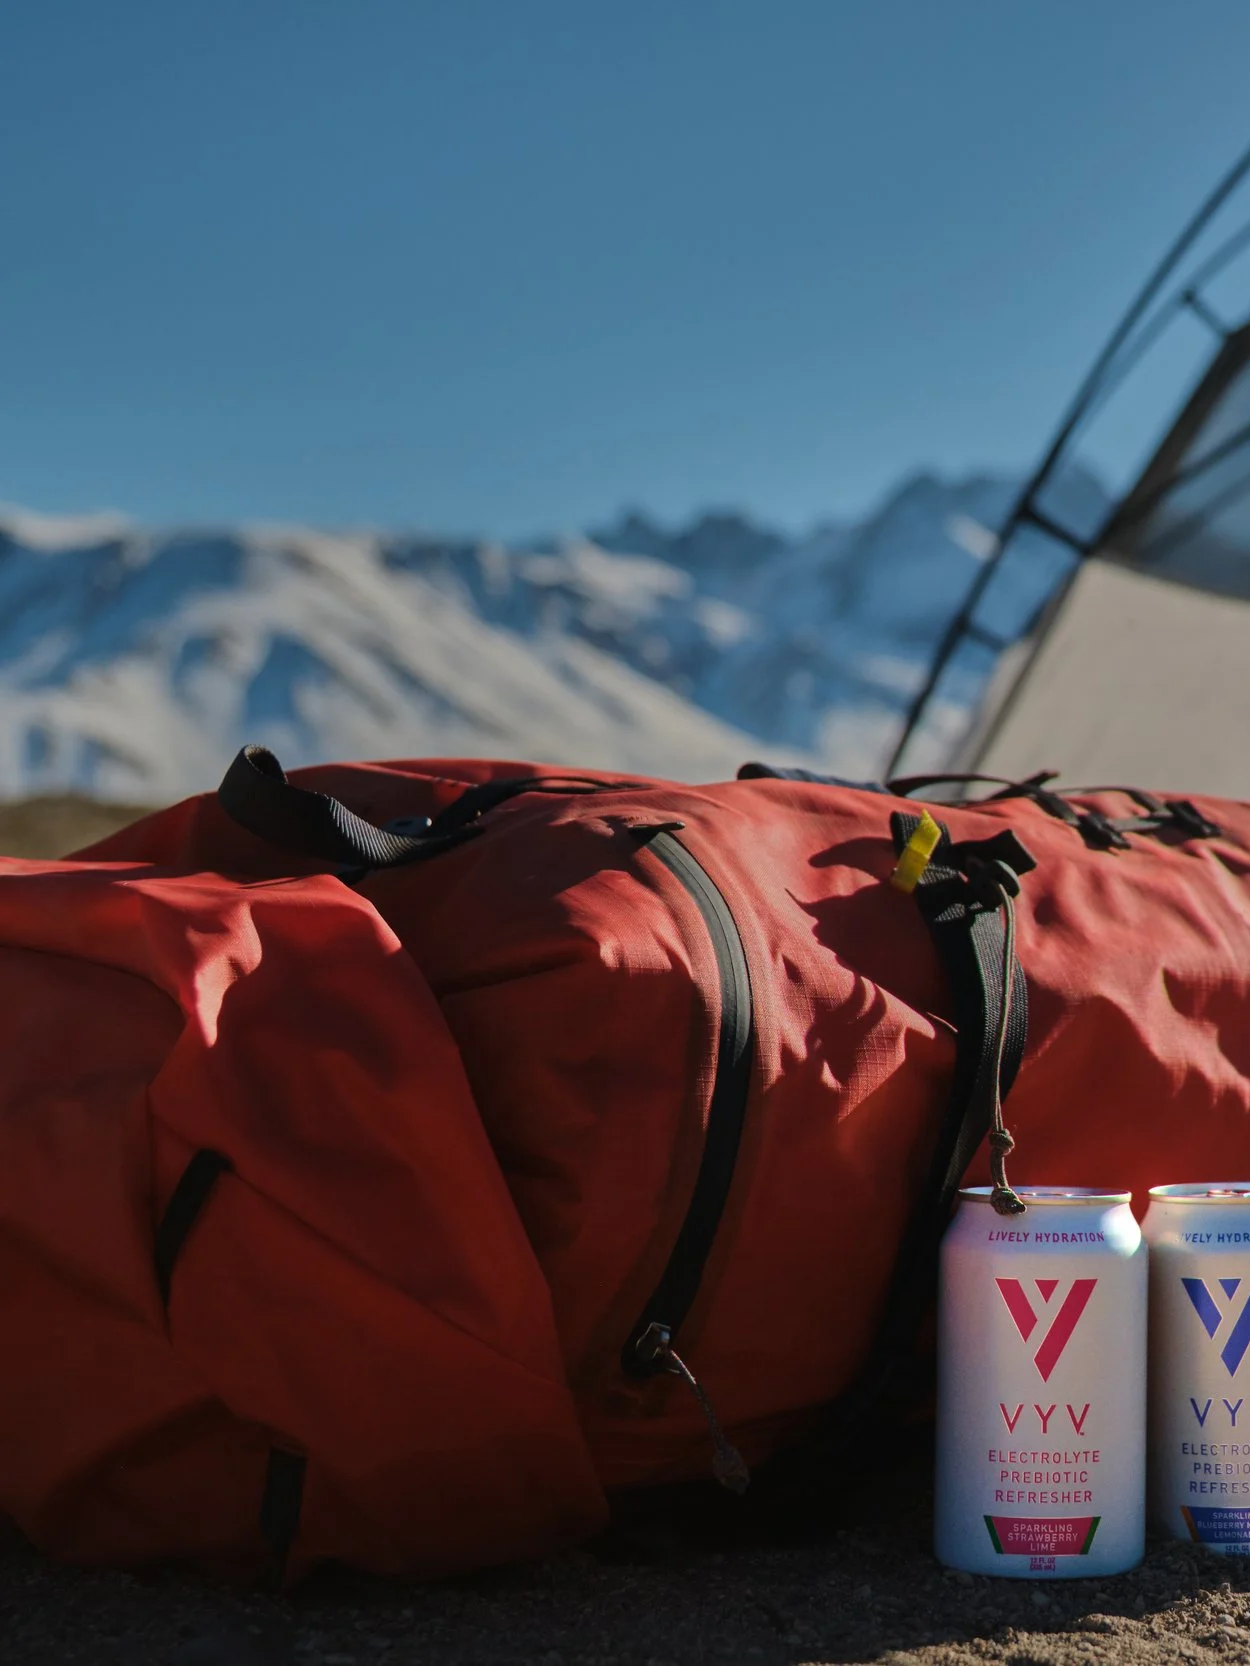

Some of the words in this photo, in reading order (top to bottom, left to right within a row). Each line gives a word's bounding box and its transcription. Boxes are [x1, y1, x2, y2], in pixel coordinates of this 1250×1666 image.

[988, 1231, 1030, 1243] LIVELY
[1034, 1231, 1105, 1243] HYDRATION
[1000, 1403, 1091, 1435] VYV
[988, 1450, 1101, 1464] ELECTROLYTE
[1000, 1470, 1088, 1484] PREBIOTIC
[995, 1489, 1093, 1504] REFRESHER
[1013, 1523, 1073, 1533] SPARKLING
[1197, 1521, 1245, 1529] BLUEBERRY
[1007, 1532, 1078, 1542] STRAWBERRY
[1030, 1543, 1056, 1552] LIME
